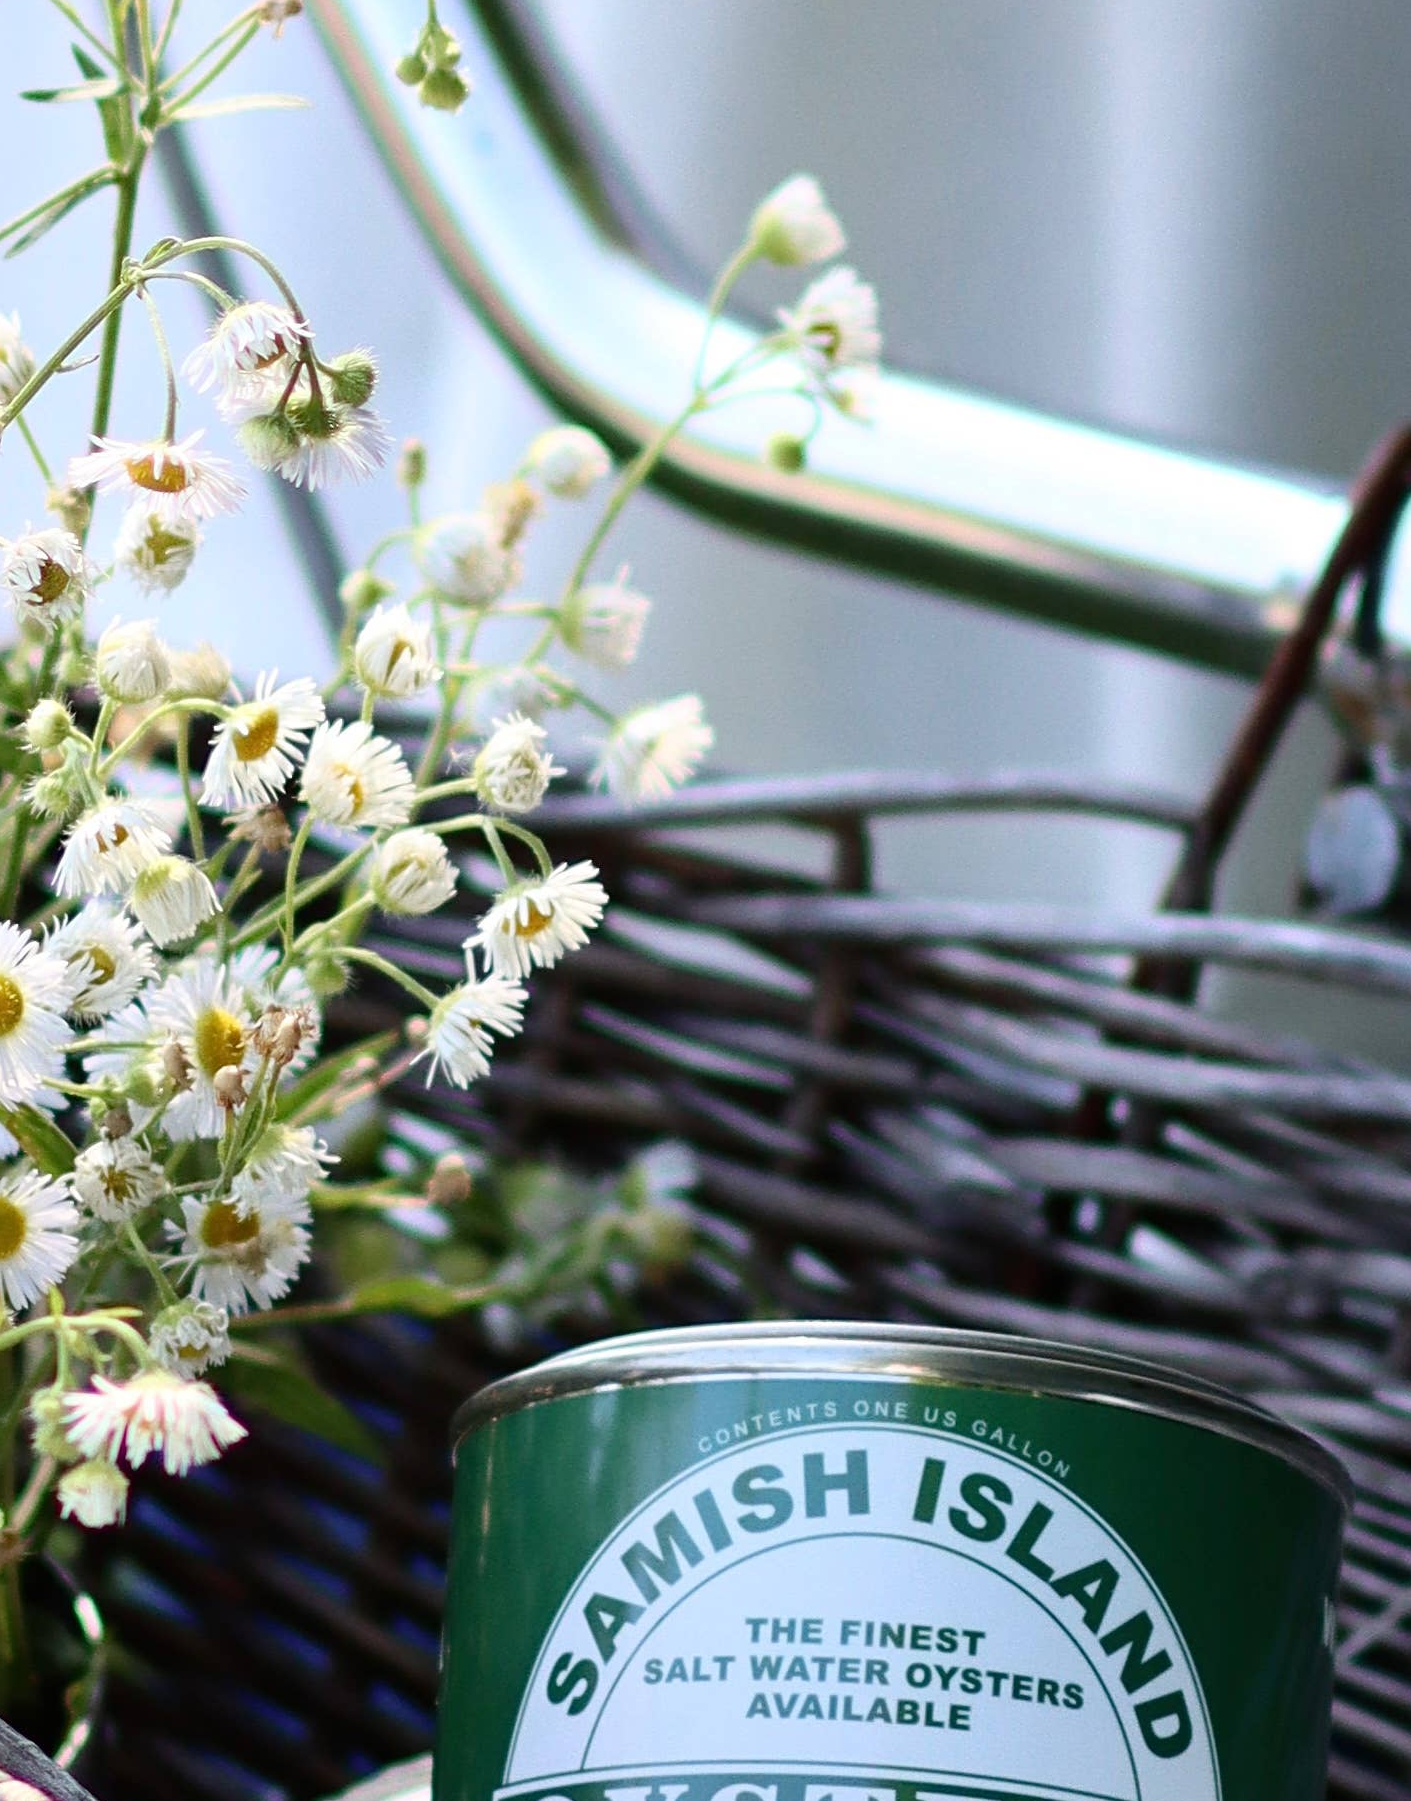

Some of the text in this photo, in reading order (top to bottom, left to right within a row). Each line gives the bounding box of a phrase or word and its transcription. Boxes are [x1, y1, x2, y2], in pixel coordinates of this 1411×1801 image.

[698, 1399, 1071, 1480] CONTENTS ONE US GALLON
[546, 1449, 1194, 1761] SAMISH ISLAND
[745, 1617, 987, 1657] THE FINEST
[643, 1654, 1085, 1710] SALT WATER OYSTERS
[745, 1692, 973, 1732] AVAILABLE
